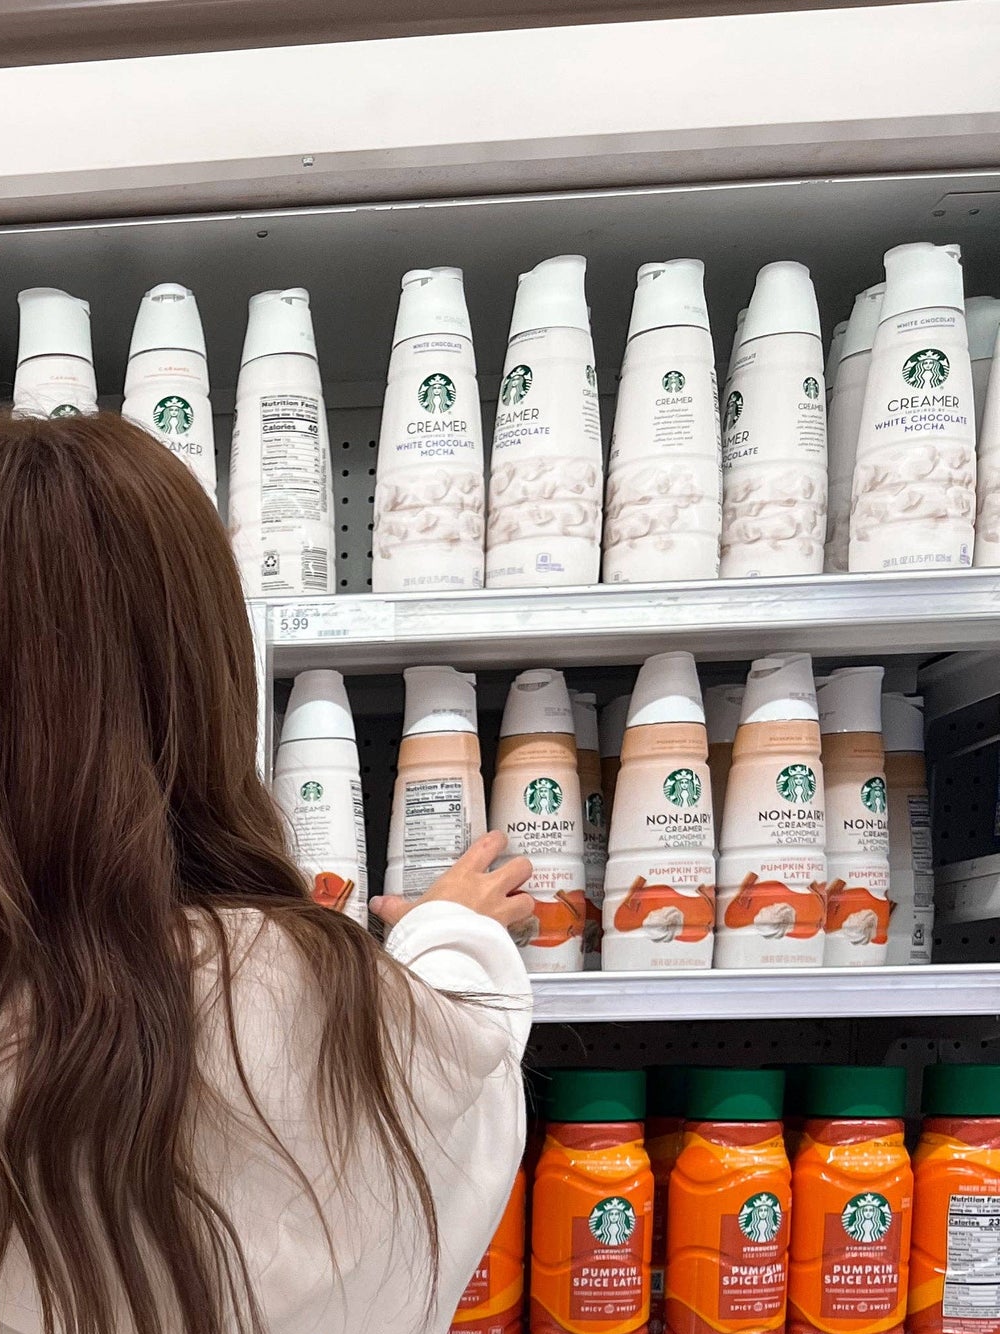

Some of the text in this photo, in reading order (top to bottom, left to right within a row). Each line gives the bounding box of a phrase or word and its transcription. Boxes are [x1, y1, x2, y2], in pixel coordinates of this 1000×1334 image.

[887, 395, 959, 412] CREAMER
[406, 420, 467, 435] CREAMER
[875, 414, 967, 431] WHITE CHOCOLATE
[904, 422, 945, 432] MOCHA
[308, 424, 318, 433] 40
[396, 438, 475, 451] WHITE CHOCOLATE
[420, 447, 455, 457] MOCHA
[280, 617, 309, 632] 5.99
[448, 803, 461, 811] 30
[646, 813, 711, 826] NON-DAIRY
[758, 809, 824, 821] NON-DAIRY
[507, 821, 575, 832] NON-DAIRY
[665, 825, 702, 833] CREAMER
[777, 821, 816, 829] CREAMER
[649, 866, 712, 876] PUMPKIN SPICE
[760, 863, 824, 872] PUMPKIN SPICE
[672, 875, 698, 883] LATTE
[784, 871, 811, 879] LATTE
[582, 1266, 637, 1277] PUMPKIN
[731, 1263, 782, 1275] PUMPKIN
[833, 1264, 893, 1274] PUMPKIN
[573, 1276, 642, 1287] SPICE LATTE
[722, 1276, 758, 1286] SPICE
[824, 1274, 898, 1285] SPICE LATTE
